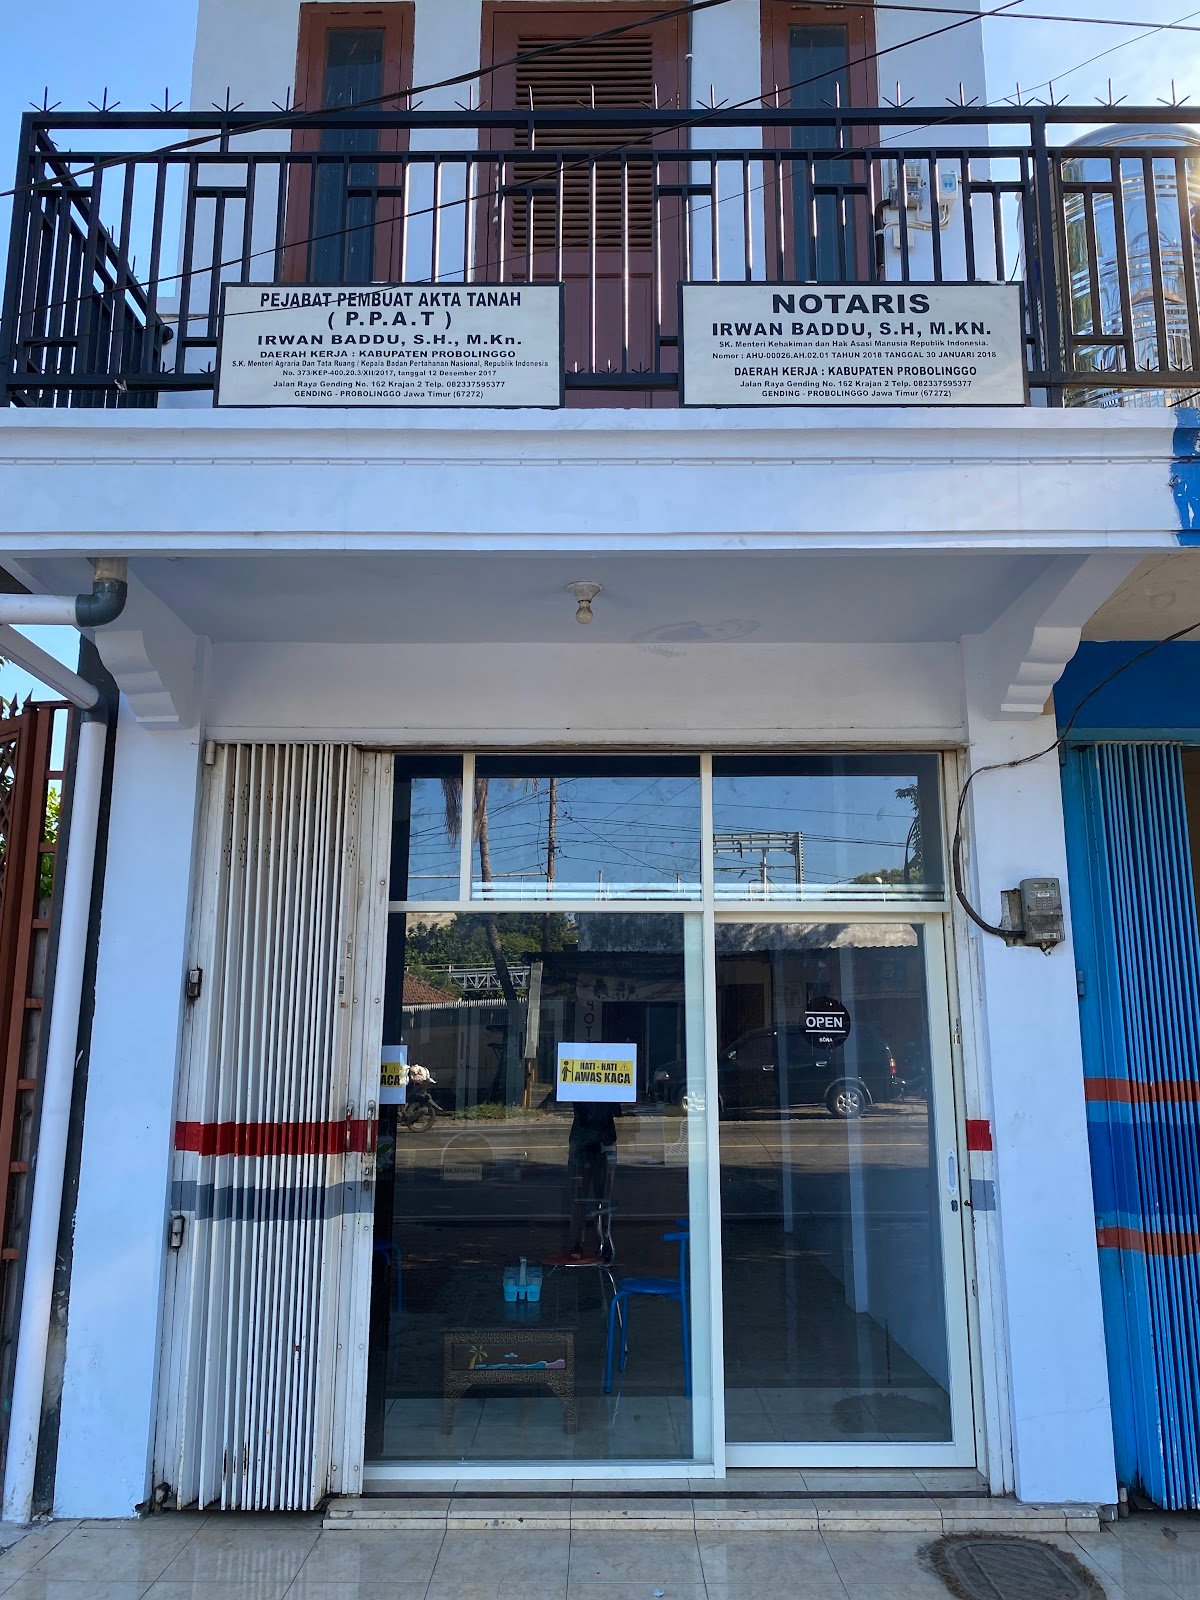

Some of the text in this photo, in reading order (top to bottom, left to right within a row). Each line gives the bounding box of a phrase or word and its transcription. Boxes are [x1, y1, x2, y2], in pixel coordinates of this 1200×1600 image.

[260, 292, 521, 308] PEJABAT PEMBUAT AKTA TANAH
[772, 293, 931, 315] NOTARIS
[712, 321, 992, 339] IRWAN BADDU, S.H, M.KN.
[257, 334, 522, 347] IRWAN BADDU, S.H., M.Kn.
[910, 340, 945, 348] Republik
[310, 350, 348, 358] KERJA
[359, 350, 428, 358] KABUPATEN
[431, 350, 516, 358] PROBOLINGGO
[231, 360, 246, 368] S.K.
[275, 360, 300, 369] Agraria
[334, 360, 355, 369] Ruang
[361, 360, 384, 369] Kepala
[450, 360, 482, 368] Nasional,
[484, 360, 514, 369] Republik
[398, 370, 426, 378] tanggal
[734, 366, 779, 377] DAERAH
[782, 366, 819, 377] KERJA
[828, 366, 894, 377] KABUPATEN
[897, 366, 977, 377] PROBOLINGGO
[298, 381, 318, 389] Raya
[319, 381, 353, 389] Gending
[388, 381, 415, 389] Krajan
[425, 381, 444, 389] Telp.
[764, 381, 785, 389] Raya
[787, 381, 820, 389] Gending
[855, 381, 882, 389] Krajan
[892, 380, 911, 388] Telp.
[453, 391, 484, 399] (67272)
[920, 390, 952, 398] (67272)
[805, 1016, 843, 1028] OPEN
[580, 1062, 596, 1071] HATI
[601, 1063, 617, 1072] HATI
[575, 1071, 631, 1084] AWAS KACA
